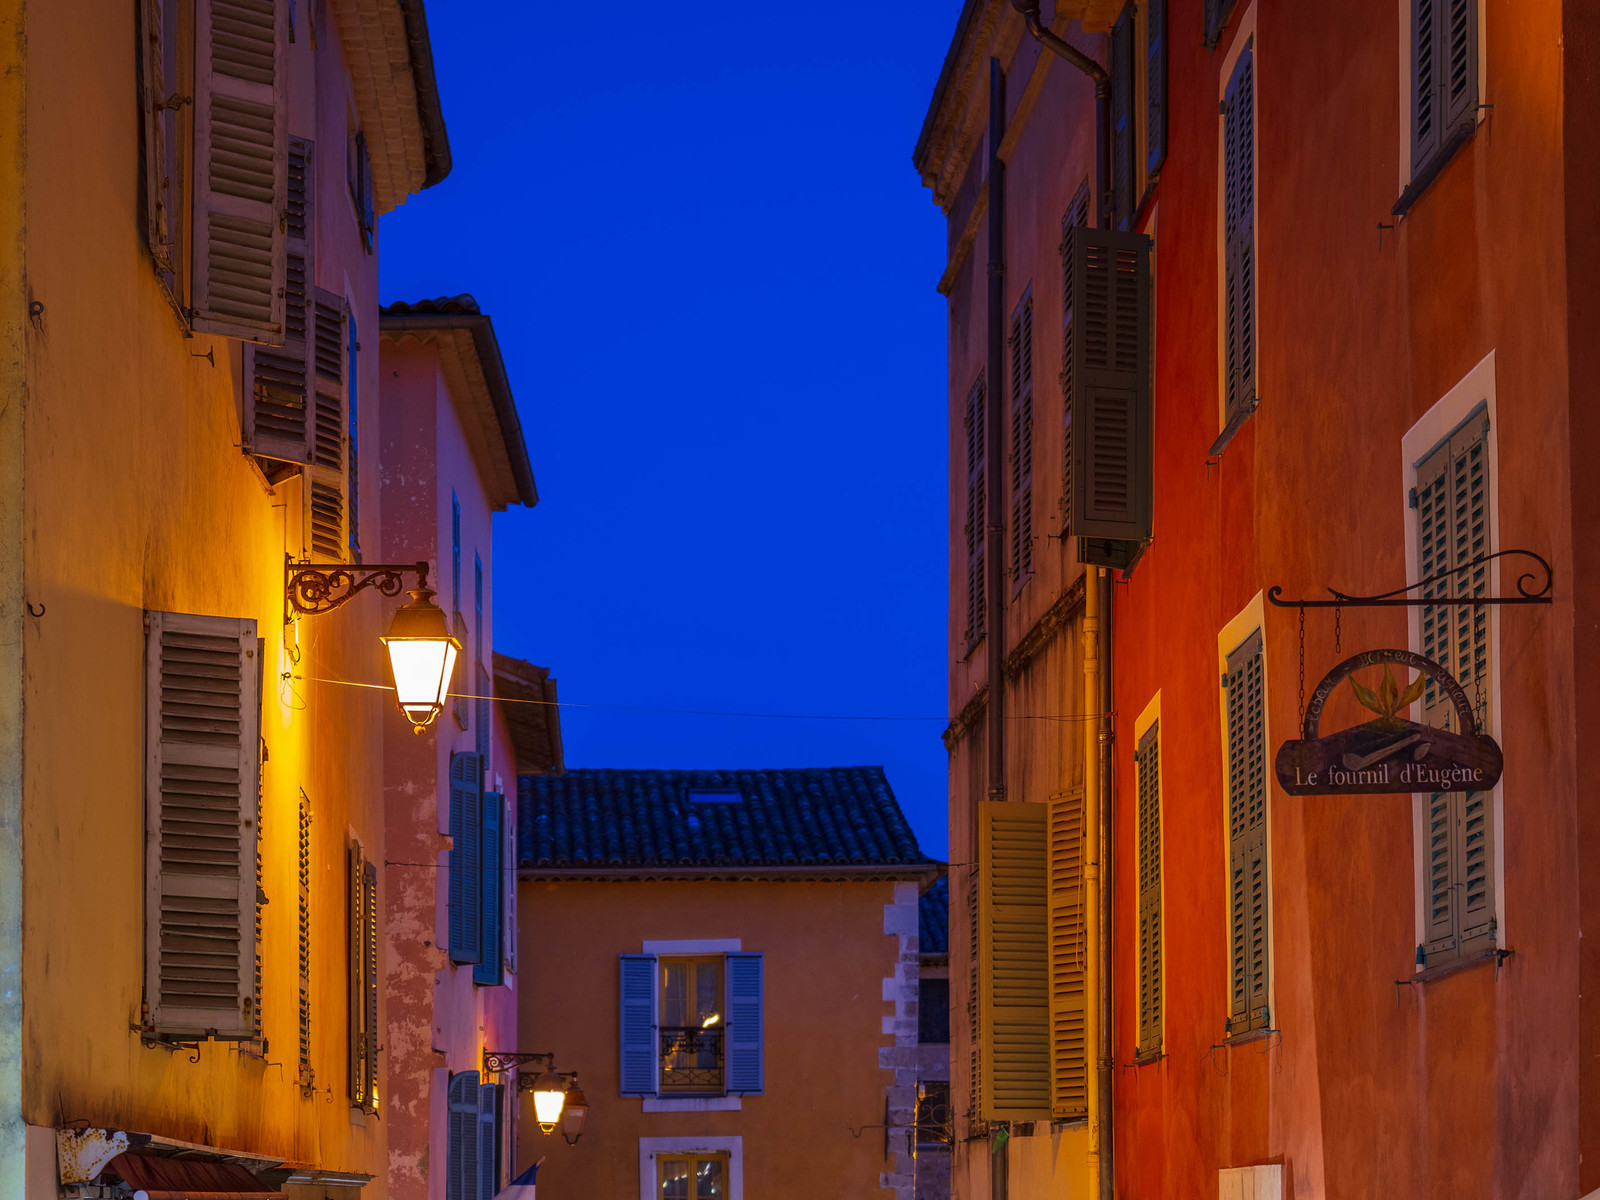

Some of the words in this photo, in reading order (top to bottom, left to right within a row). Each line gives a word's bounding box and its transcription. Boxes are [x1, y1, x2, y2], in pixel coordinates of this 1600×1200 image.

[1295, 766, 1318, 786] Le
[1328, 763, 1390, 786] fournil
[1400, 762, 1483, 790] d'Eugène
